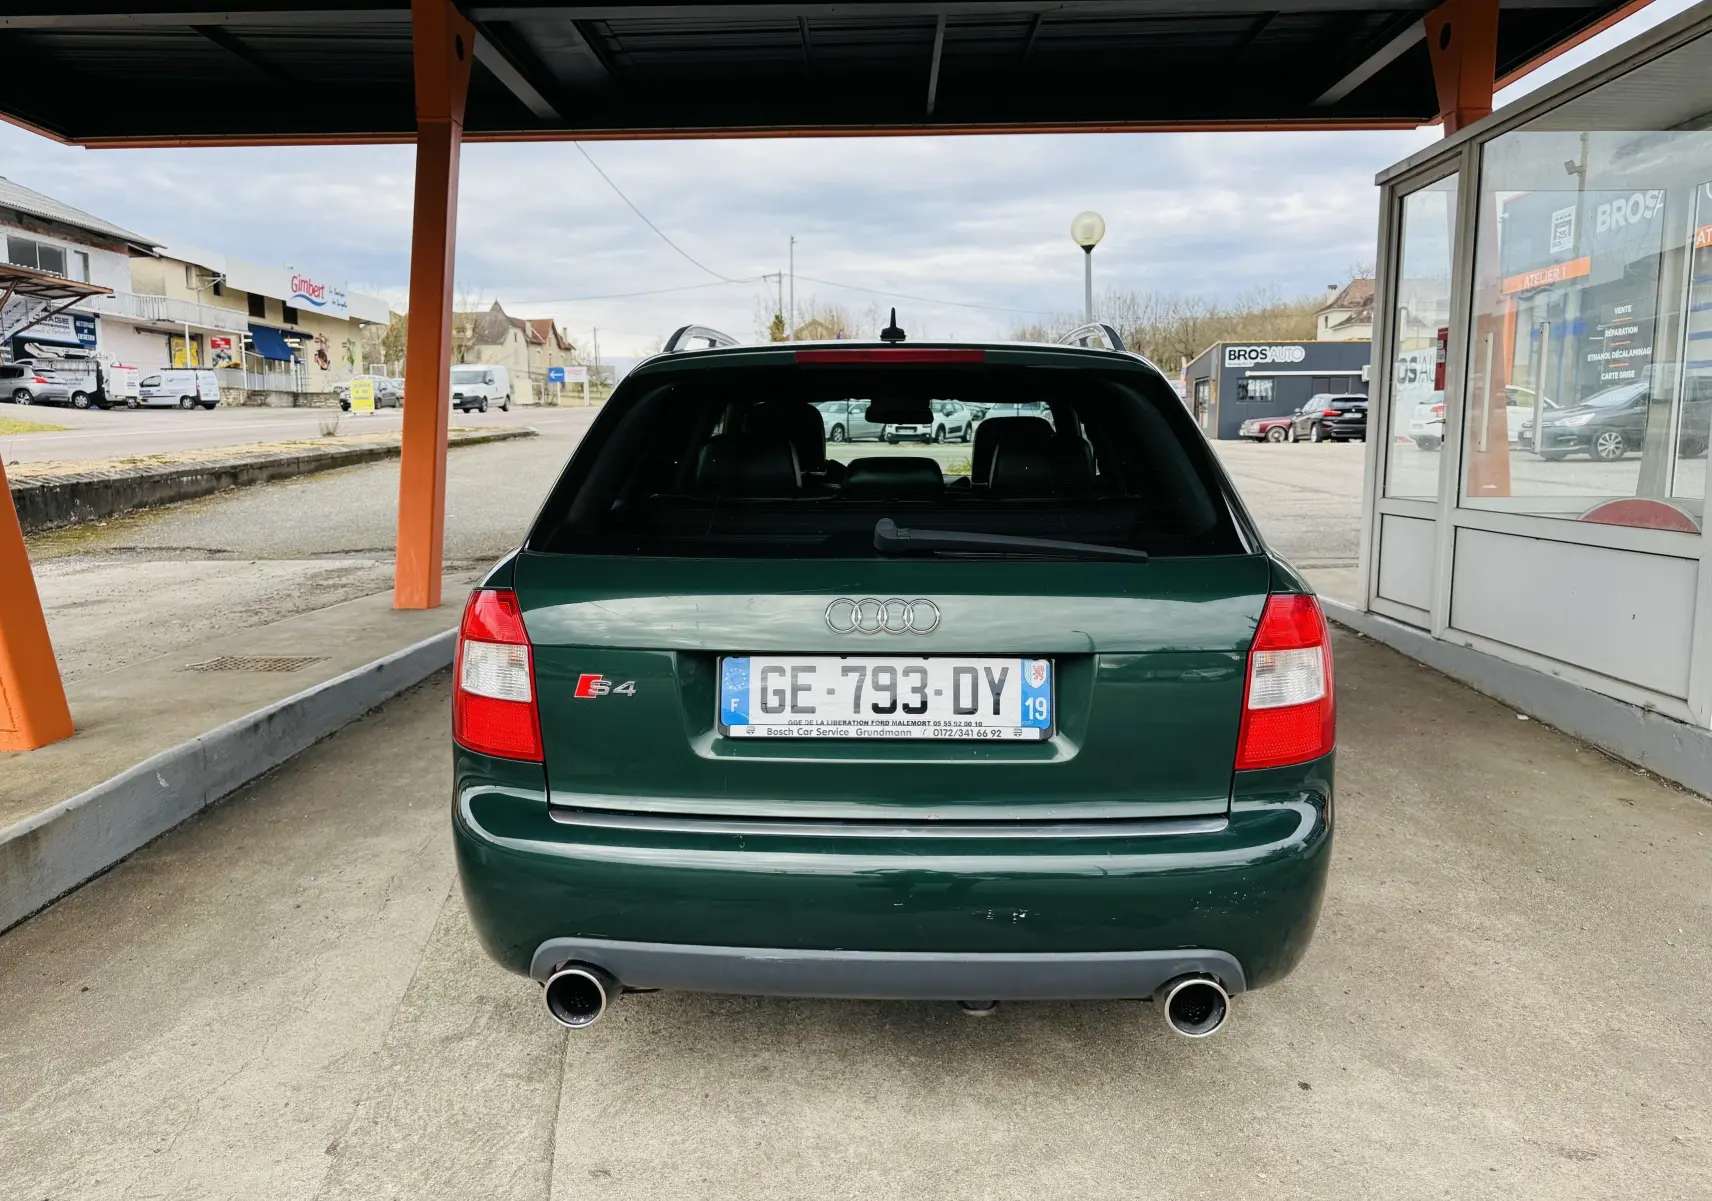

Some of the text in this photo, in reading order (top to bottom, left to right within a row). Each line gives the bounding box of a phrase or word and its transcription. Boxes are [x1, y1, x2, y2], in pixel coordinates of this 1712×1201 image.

[1523, 267, 1560, 289] ATELIER
[291, 273, 325, 299] Gimbert
[1613, 304, 1632, 315] VENTE
[1604, 325, 1639, 338] RÉPARATION
[1611, 347, 1653, 359] DÉCALAMINAG
[1601, 370, 1636, 381] CARTE GRISE
[587, 679, 638, 697] S4
[730, 698, 740, 713] F
[1024, 696, 1048, 721] 19
[766, 727, 1002, 737] Bosch Car Service Grundmann 0172/341 66 92
